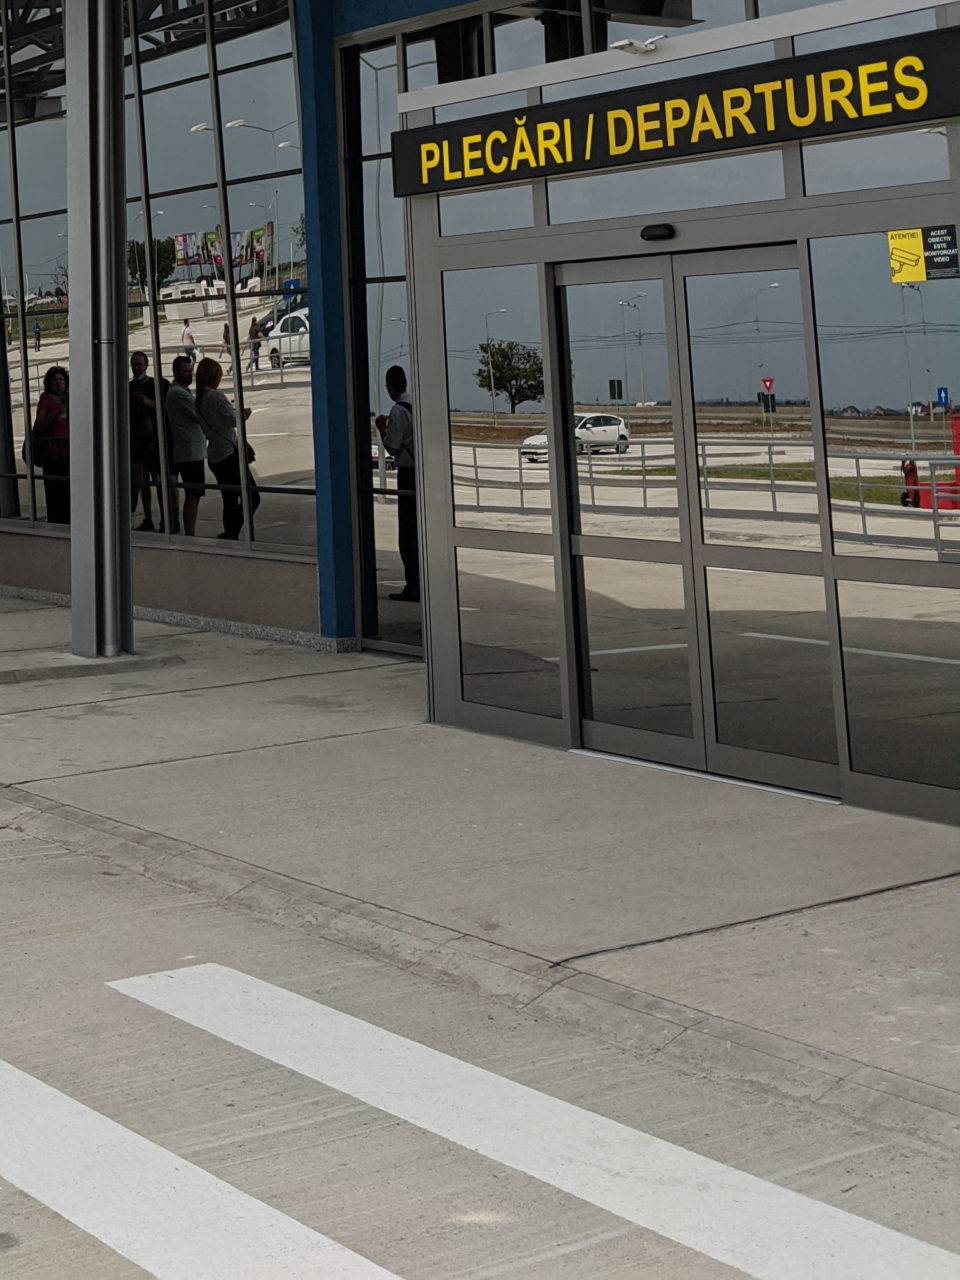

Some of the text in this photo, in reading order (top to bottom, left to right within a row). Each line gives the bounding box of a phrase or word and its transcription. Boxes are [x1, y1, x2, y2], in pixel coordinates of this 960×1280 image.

[420, 115, 573, 185] PLECĂRI
[607, 56, 929, 157] DEPARTURES
[924, 249, 958, 257] MONITORIZAT
